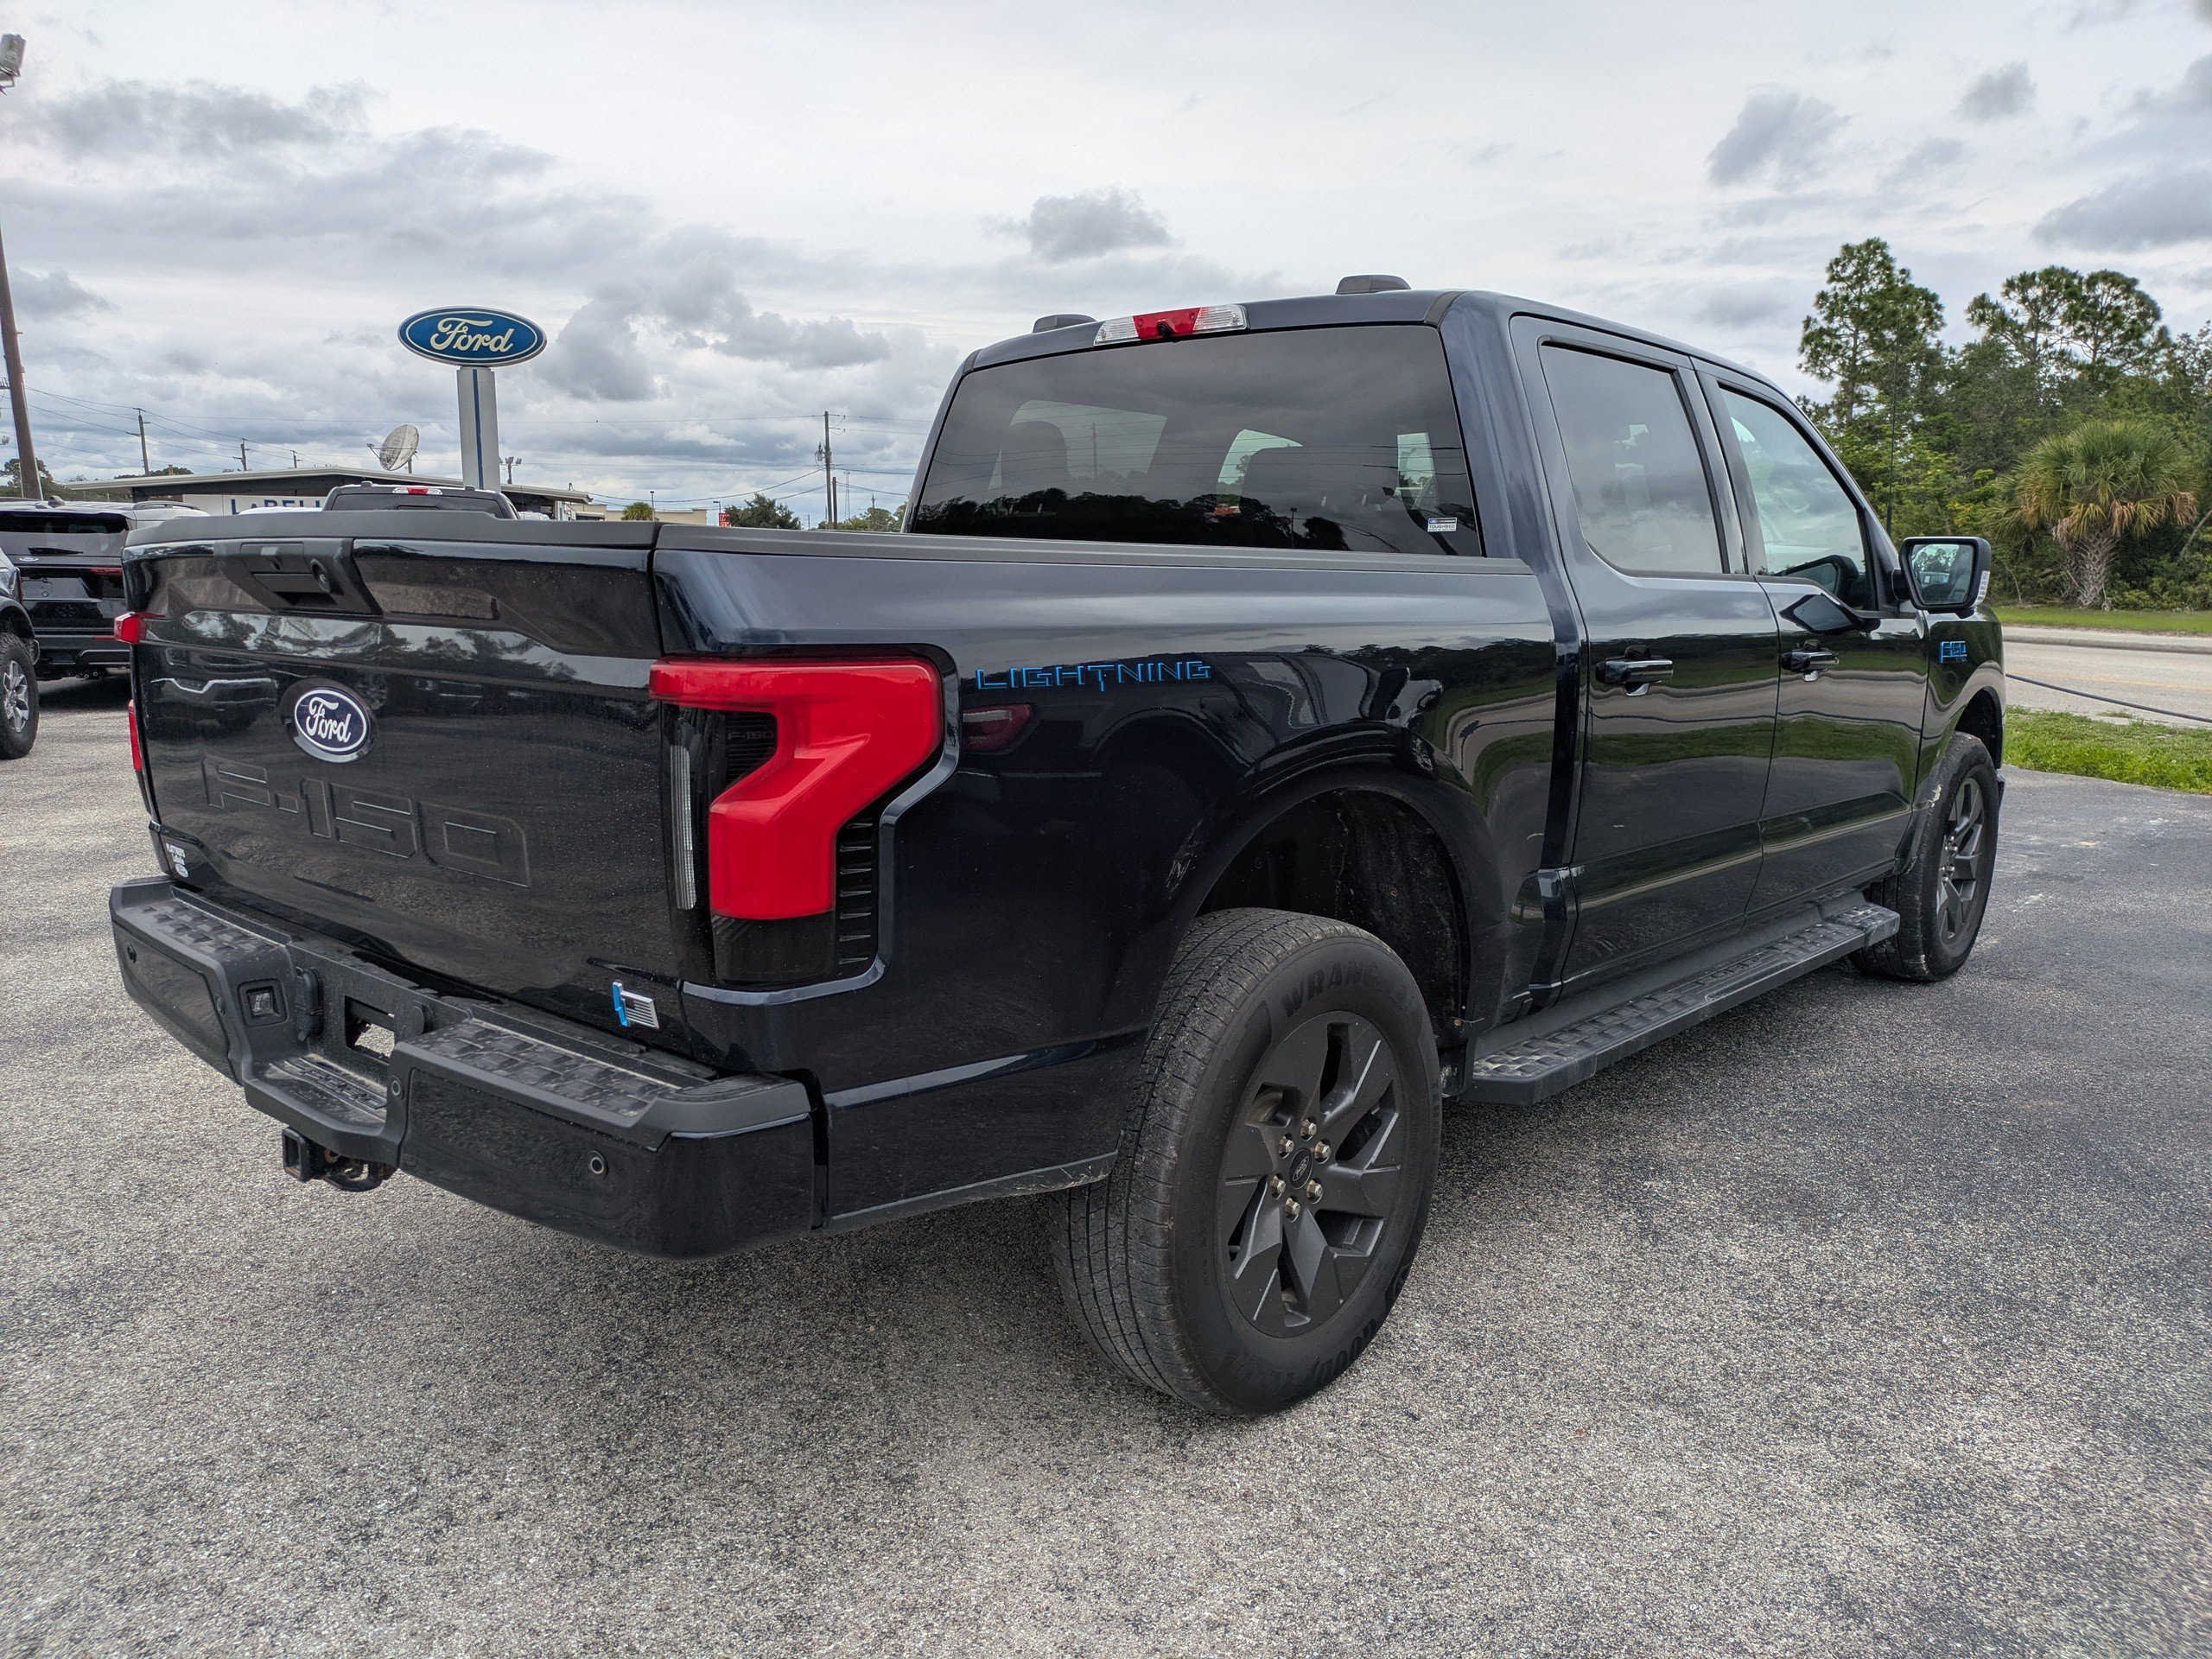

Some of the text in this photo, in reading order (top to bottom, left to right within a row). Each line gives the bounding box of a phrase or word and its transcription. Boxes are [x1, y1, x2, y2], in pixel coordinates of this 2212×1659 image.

[430, 317, 515, 353] Ford
[976, 660, 1211, 691] LIGHTNING
[305, 696, 352, 743] Ford
